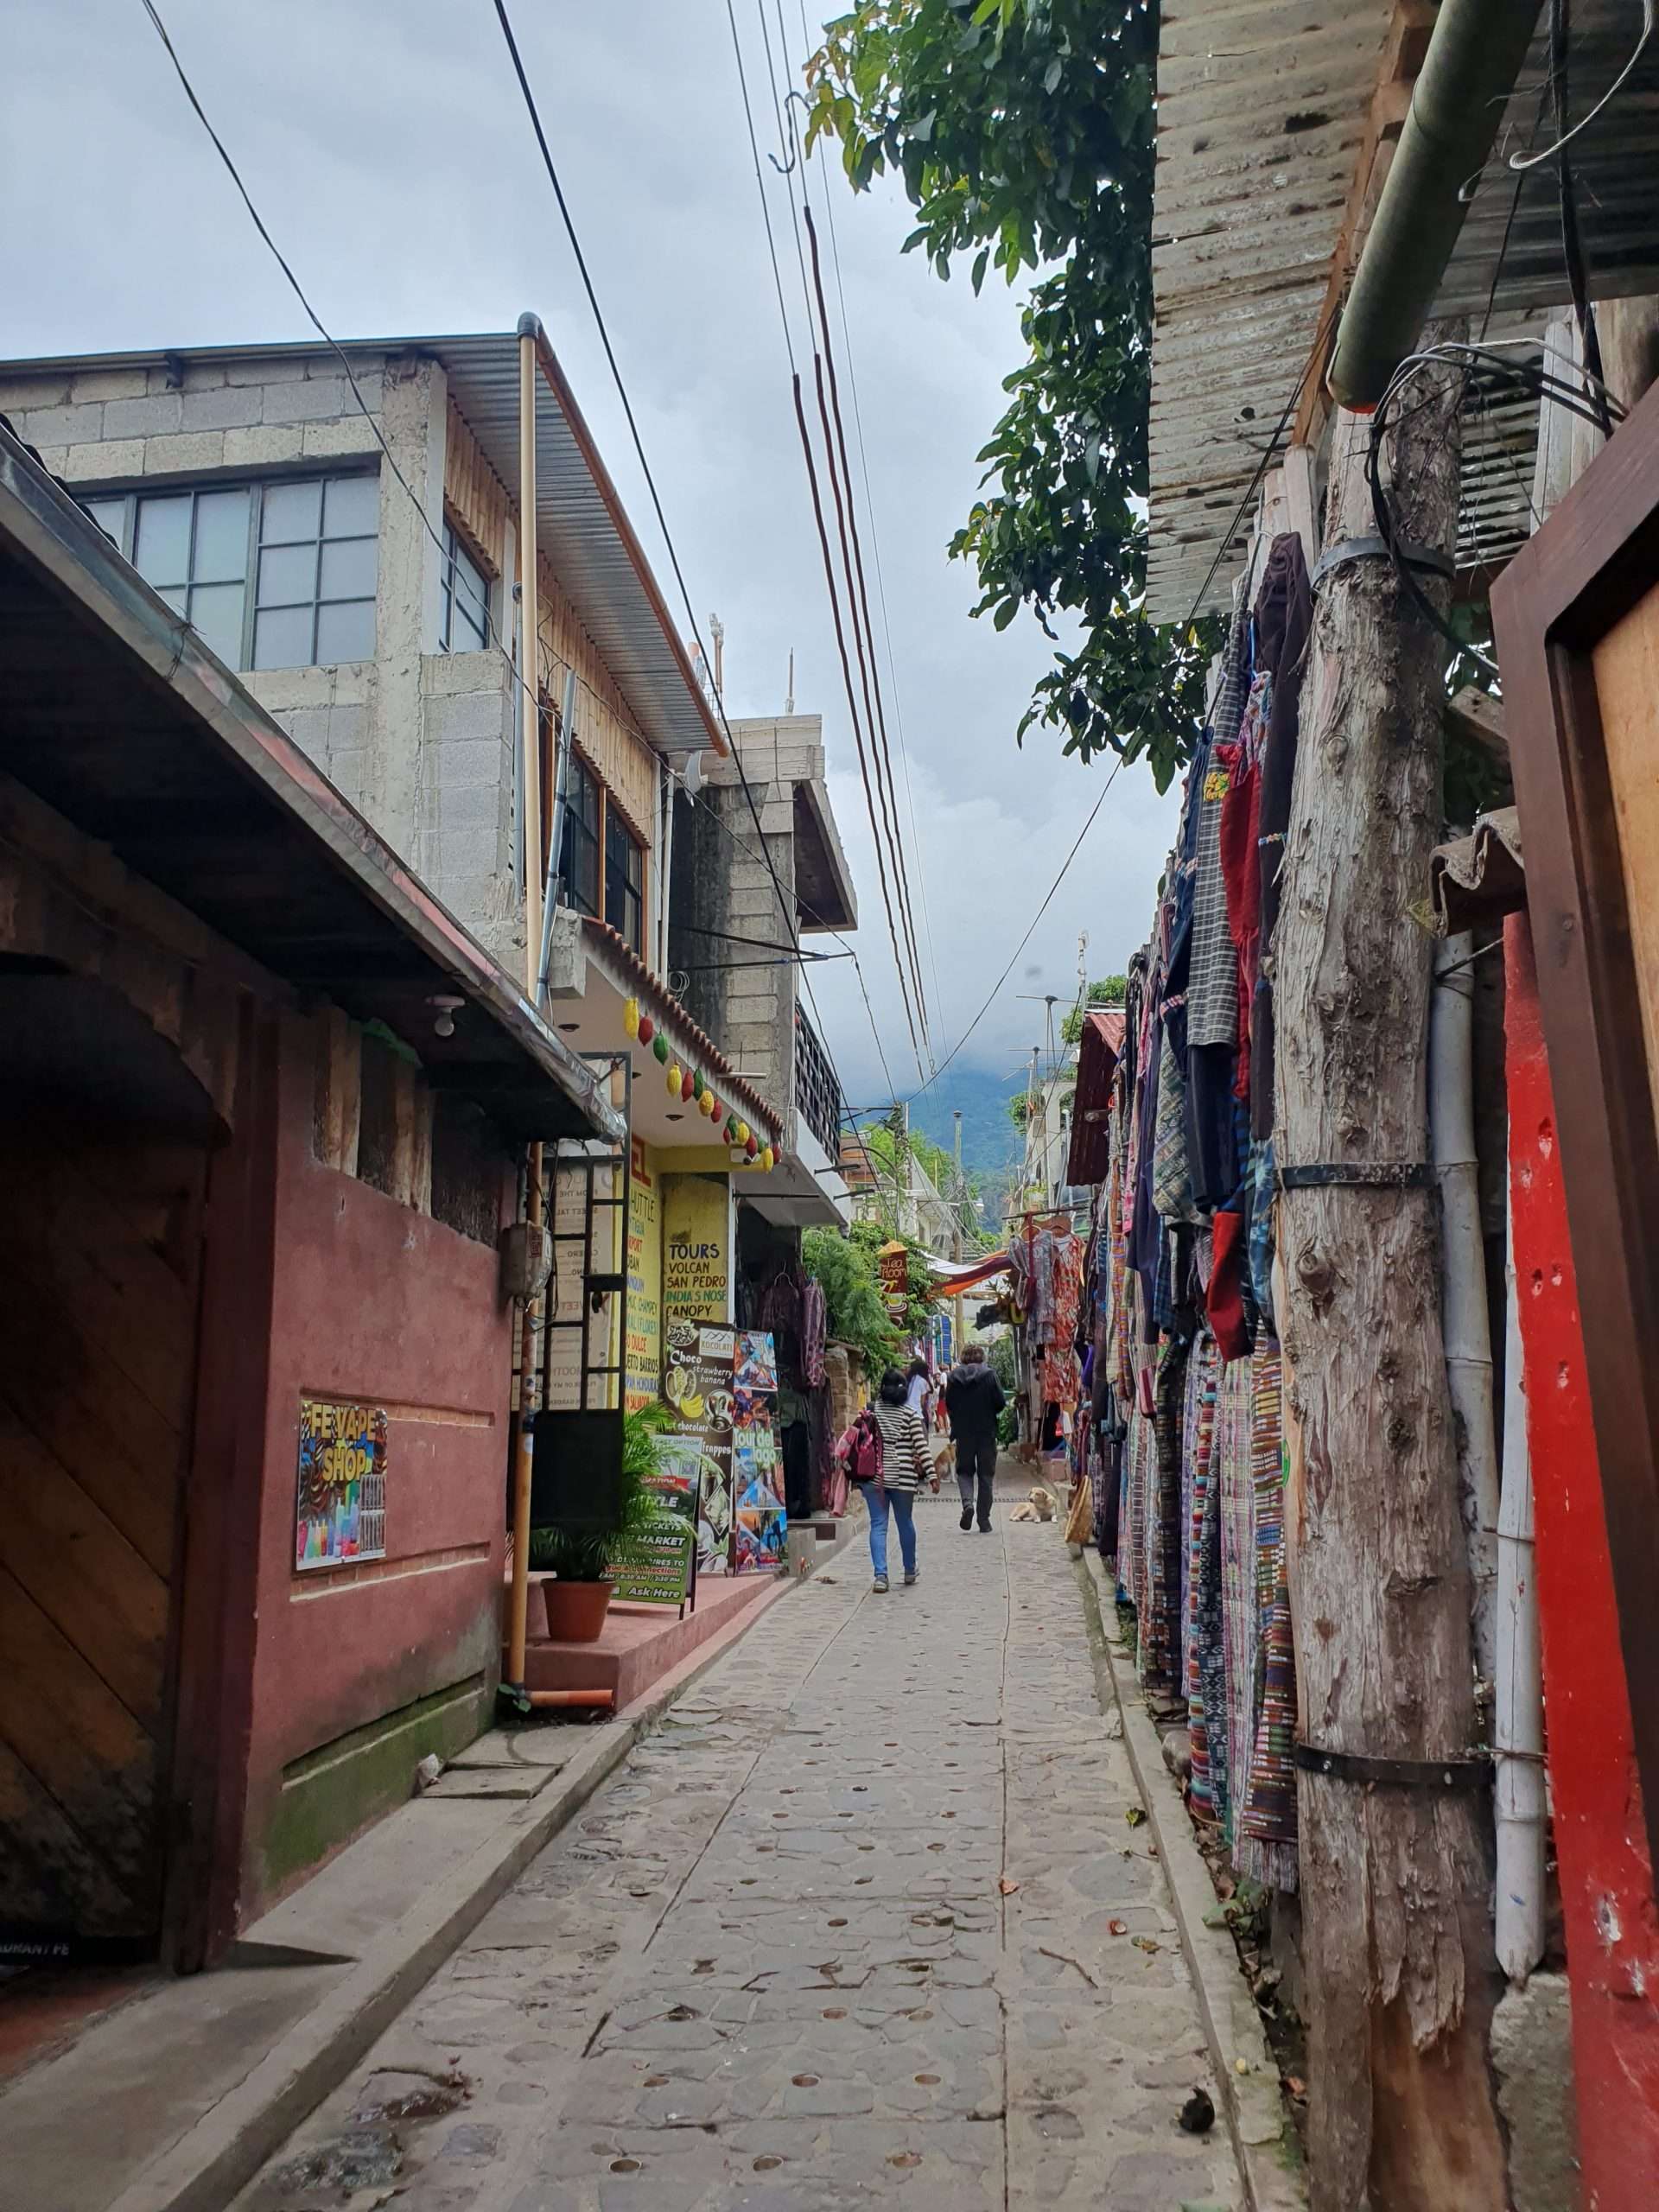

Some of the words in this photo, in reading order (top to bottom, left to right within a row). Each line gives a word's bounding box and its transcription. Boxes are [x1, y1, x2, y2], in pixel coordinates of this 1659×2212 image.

[631, 1189, 654, 1224] HUTTLE
[669, 1243, 720, 1260] TOURS
[669, 1262, 710, 1274] VOLCAN
[667, 1276, 688, 1288] SAN
[692, 1275, 727, 1287] PEDRO
[703, 1290, 728, 1302] NOSE
[666, 1305, 713, 1317] CANOPY
[670, 1350, 702, 1364] Choco
[639, 1356, 658, 1375] BARRIOS
[692, 1365, 734, 1379] strawberry
[700, 1375, 726, 1385] banana
[311, 1403, 332, 1439] FE
[335, 1405, 377, 1441] VAPE
[677, 1420, 709, 1433] chocolate
[734, 1428, 756, 1446] Tour
[757, 1427, 774, 1448] del
[702, 1441, 732, 1458] frappes
[322, 1447, 367, 1482] SHOP
[753, 1448, 776, 1468] lago
[637, 1535, 686, 1547] MARKET
[628, 1586, 652, 1597] Ask
[653, 1588, 680, 1599] Here
